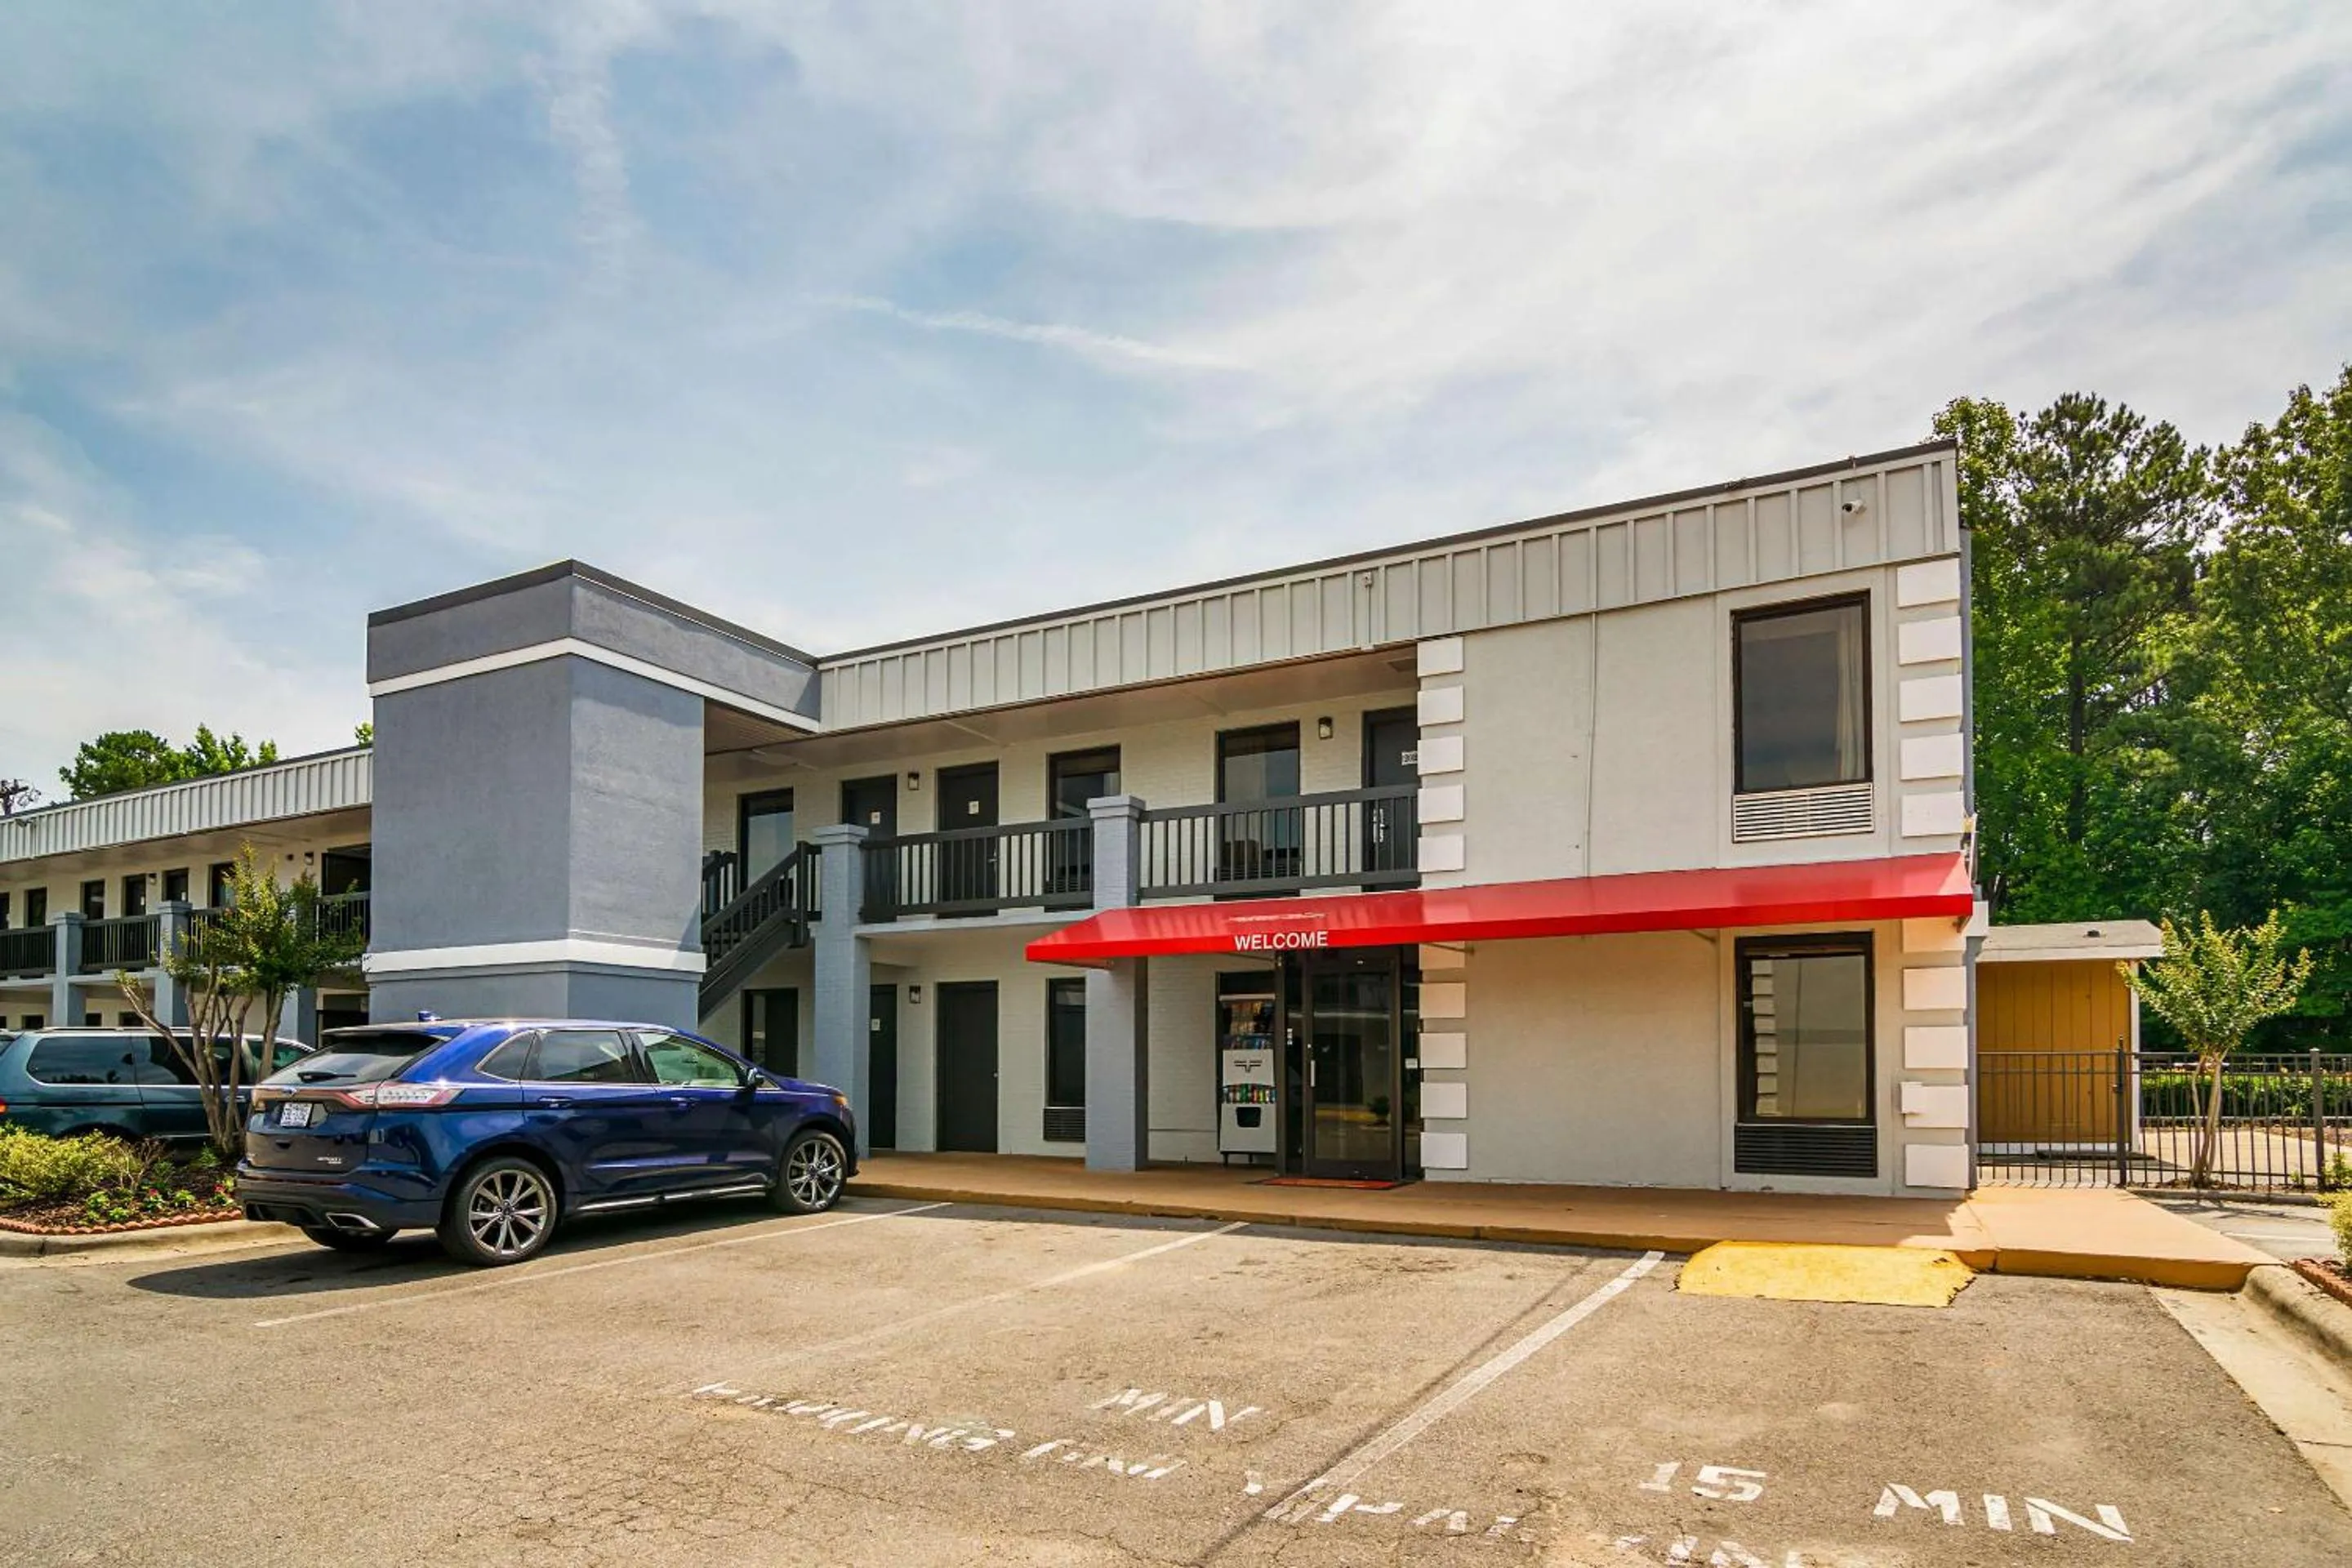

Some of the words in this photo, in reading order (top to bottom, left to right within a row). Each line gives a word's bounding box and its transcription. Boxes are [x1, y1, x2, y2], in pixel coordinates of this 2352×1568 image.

[1234, 931, 1329, 951] WELCOME
[1637, 1462, 1767, 1502] 15
[1873, 1482, 2134, 1543] MIN
